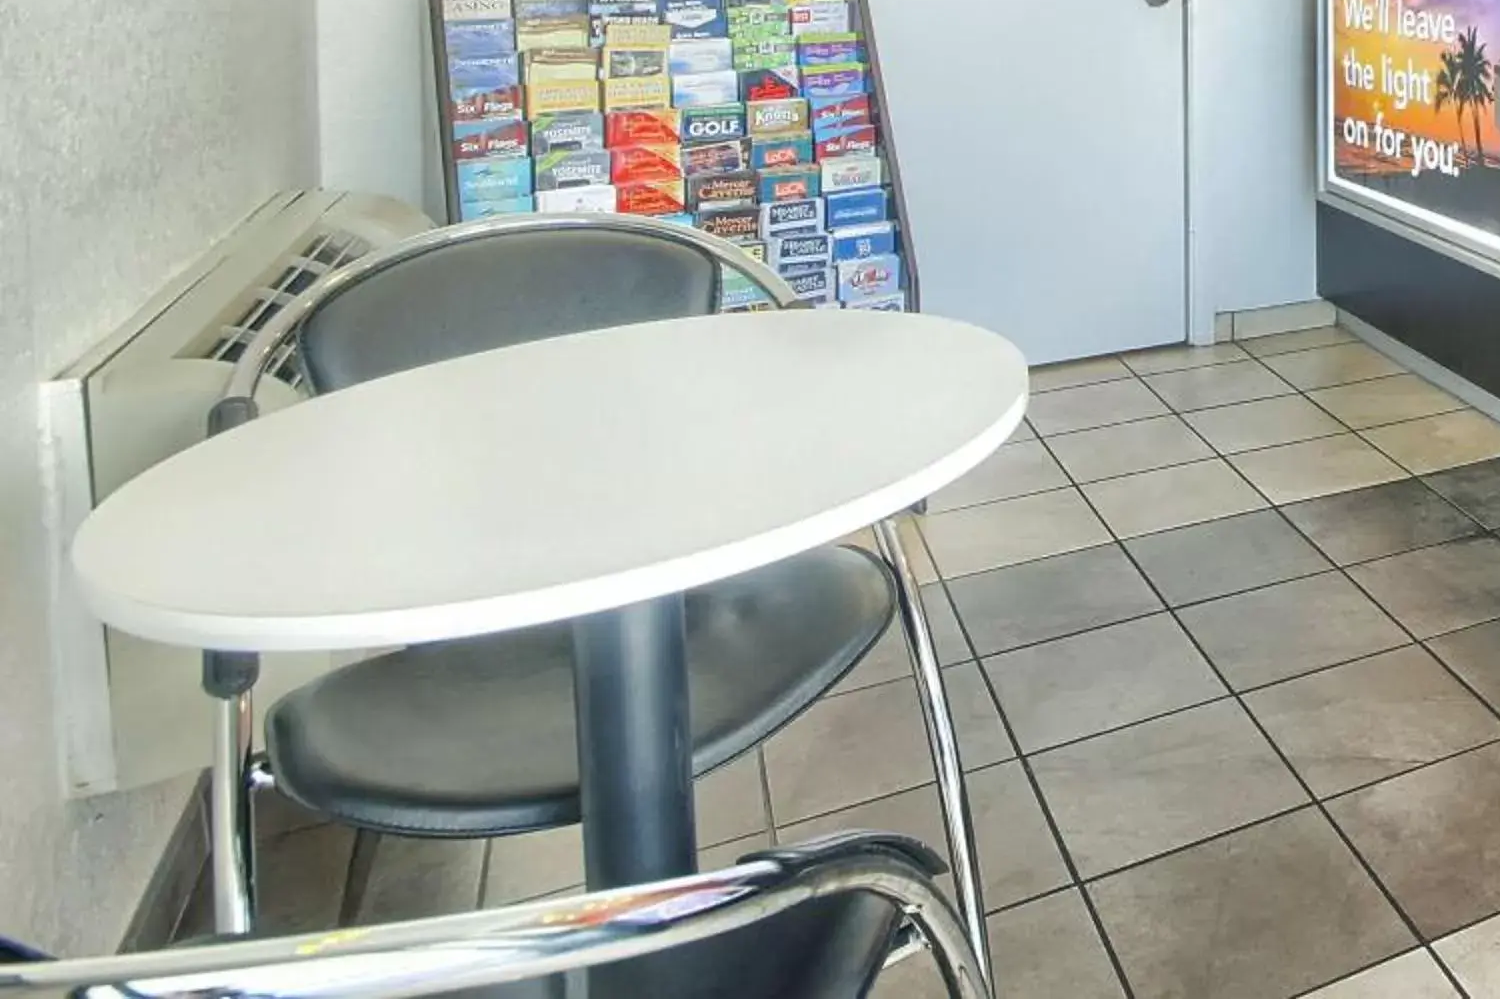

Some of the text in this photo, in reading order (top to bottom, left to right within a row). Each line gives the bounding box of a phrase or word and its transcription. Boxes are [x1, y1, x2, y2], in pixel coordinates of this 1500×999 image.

[1343, 48, 1431, 109] the light
[457, 104, 476, 113] Six
[689, 120, 740, 137] GOLF
[1343, 116, 1369, 148] on
[1374, 111, 1404, 158] for
[460, 143, 480, 152] Six
[826, 143, 841, 152] Six
[715, 215, 753, 226] Mercer
